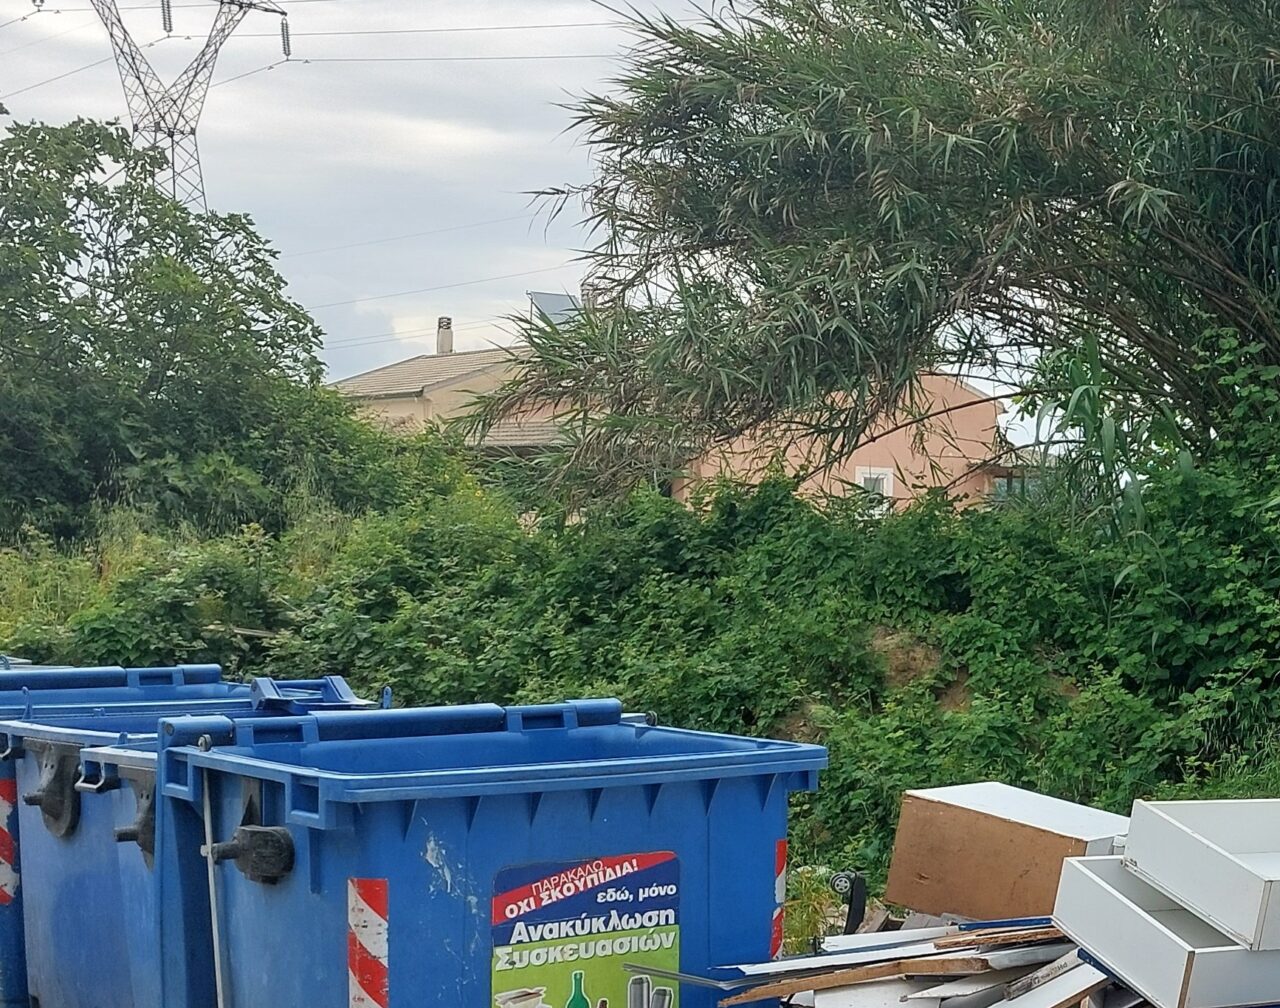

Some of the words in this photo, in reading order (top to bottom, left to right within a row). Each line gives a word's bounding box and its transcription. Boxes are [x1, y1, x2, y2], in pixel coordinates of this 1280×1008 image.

[505, 896, 536, 919] ΟΧΙ
[597, 886, 634, 903] εδώ,
[638, 883, 677, 902] μόνο
[509, 908, 675, 945] Ανακύκλωση
[495, 928, 676, 972] Συσκευασιών
